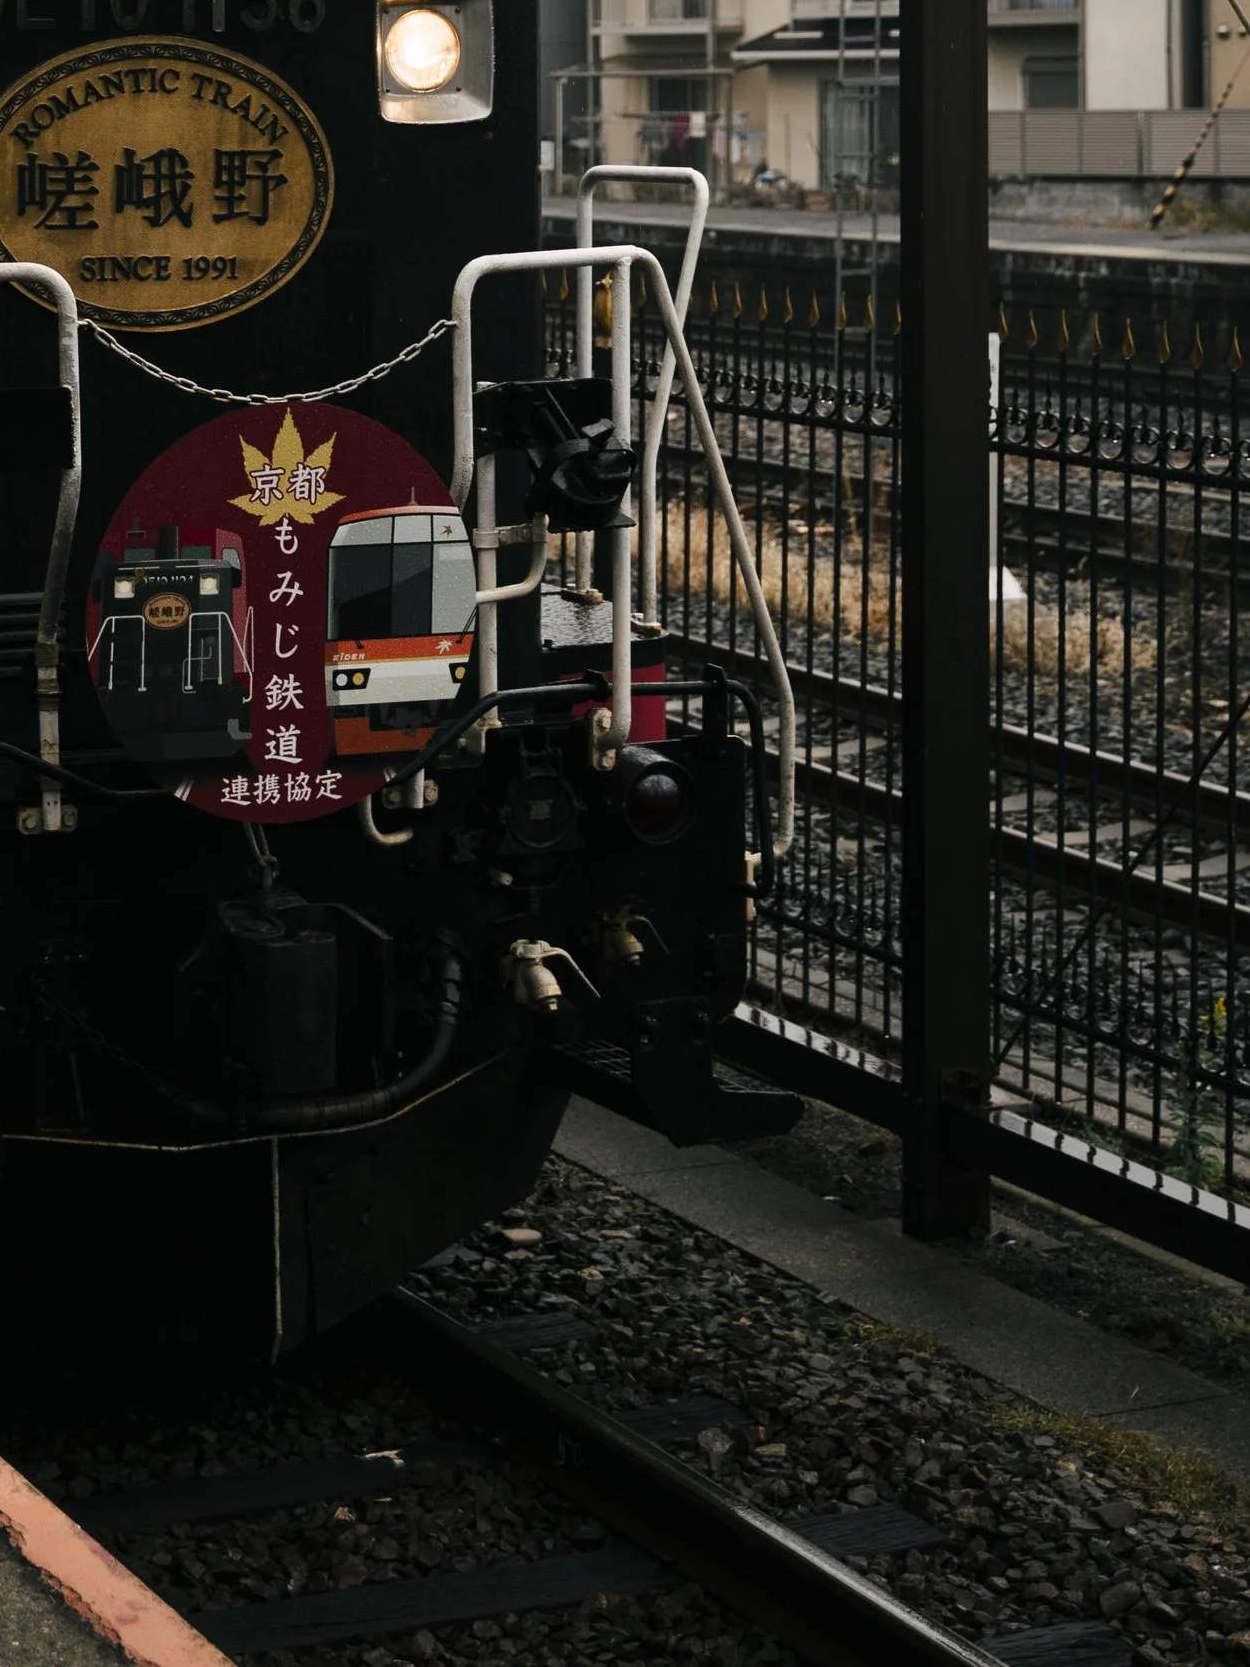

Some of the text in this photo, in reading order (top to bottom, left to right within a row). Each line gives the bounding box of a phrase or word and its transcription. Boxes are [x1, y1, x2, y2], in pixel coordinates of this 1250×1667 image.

[10, 67, 291, 150] ROMANTIC TRAIN
[16, 147, 289, 231] 嵯峨野
[79, 255, 239, 283] SINCE 1991
[249, 462, 326, 506] 京都
[263, 518, 305, 766] もみじ鉄道
[220, 769, 343, 807] 連携協定
